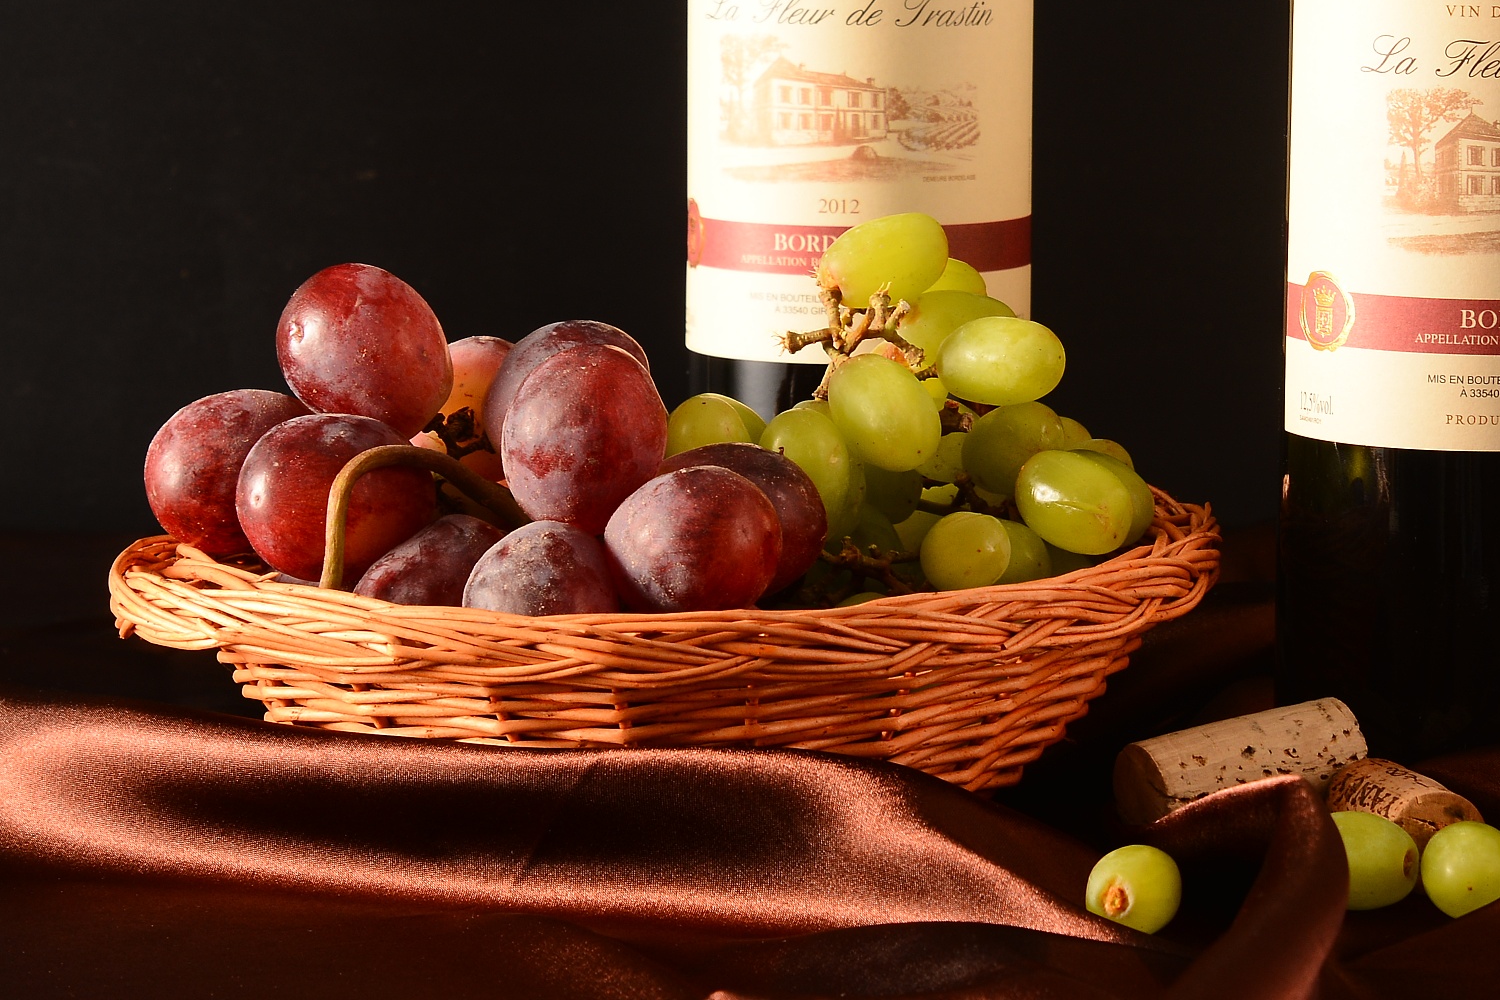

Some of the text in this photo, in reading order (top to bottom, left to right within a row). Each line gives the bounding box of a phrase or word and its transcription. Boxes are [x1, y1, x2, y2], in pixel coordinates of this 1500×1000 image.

[1446, 5, 1480, 18] VIN
[1360, 34, 1418, 75] La
[818, 198, 860, 214] 2012
[741, 254, 807, 267] APPELLATION
[766, 292, 778, 301] EN
[782, 306, 809, 315] 33540
[1415, 333, 1499, 346] APPELLATION
[1427, 374, 1446, 384] MIS
[1449, 375, 1464, 384] EN
[1460, 386, 1467, 398] À
[1469, 389, 1500, 398] 33540
